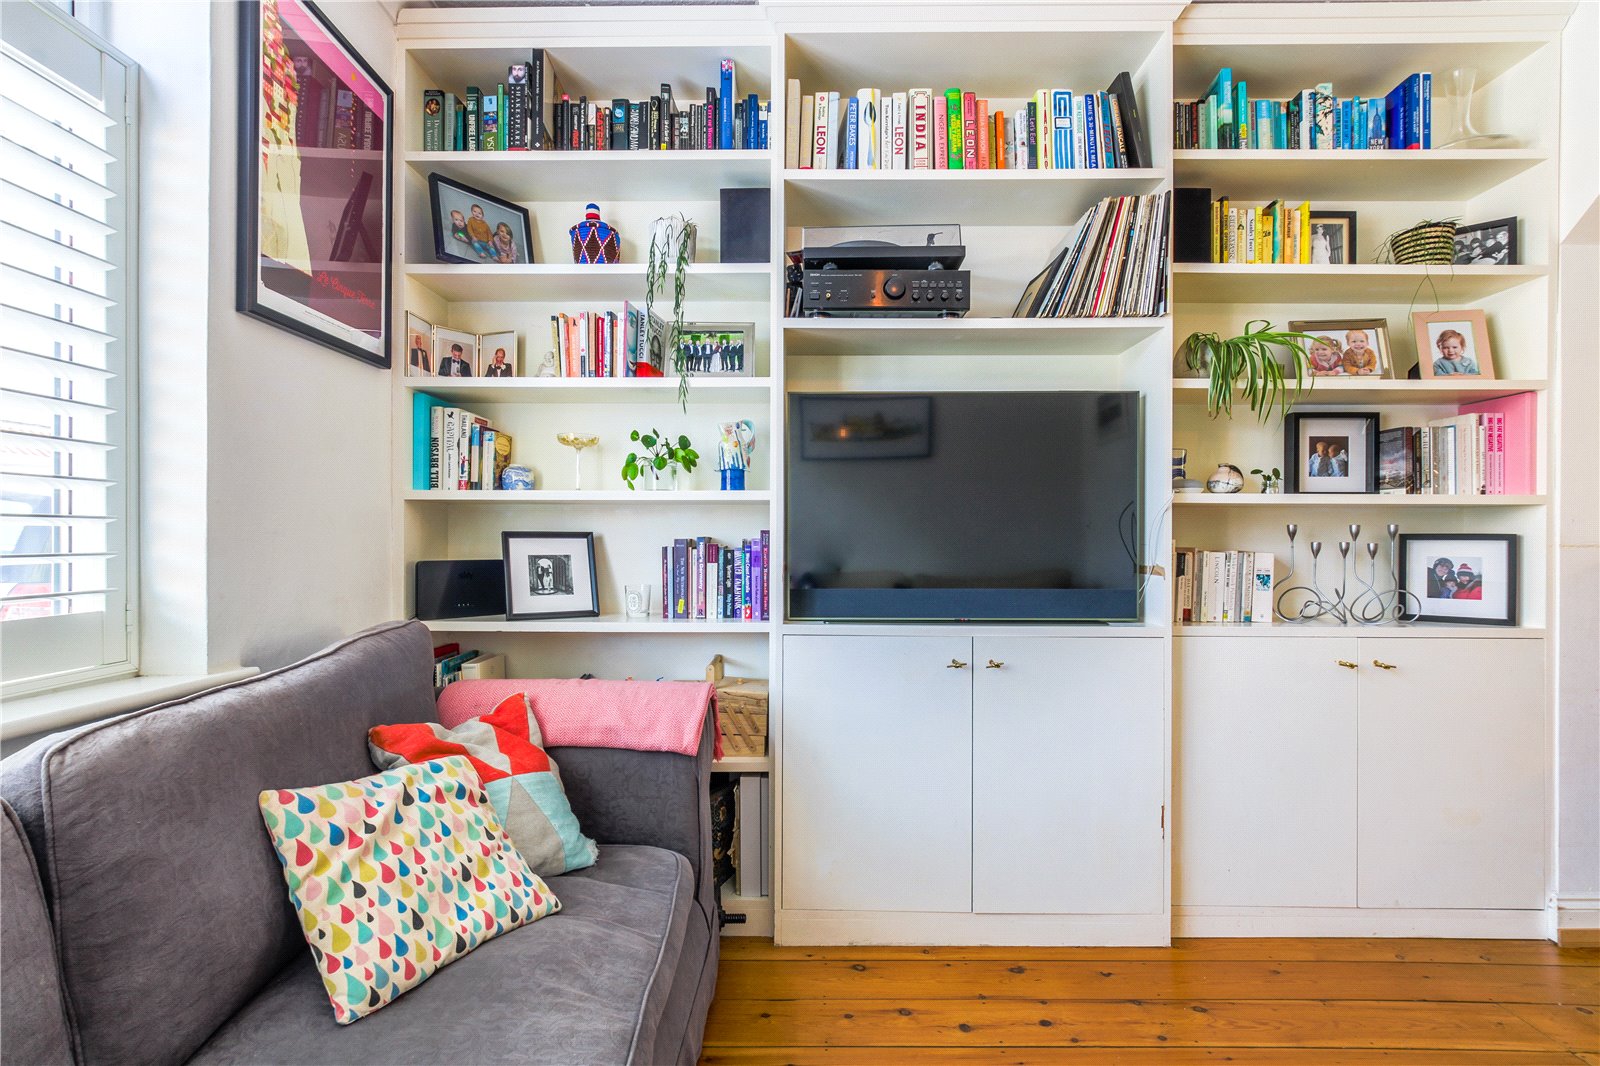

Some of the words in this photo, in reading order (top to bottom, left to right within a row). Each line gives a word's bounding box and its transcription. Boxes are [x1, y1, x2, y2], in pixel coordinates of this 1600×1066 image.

[816, 126, 825, 154] LEON
[895, 127, 903, 155] LEON
[916, 105, 926, 151] INDIA
[966, 120, 974, 158] LEON
[1104, 124, 1112, 153] LEON
[1117, 128, 1125, 152] PASCALE
[431, 437, 439, 468] BRYSON
[431, 468, 439, 488] BILL
